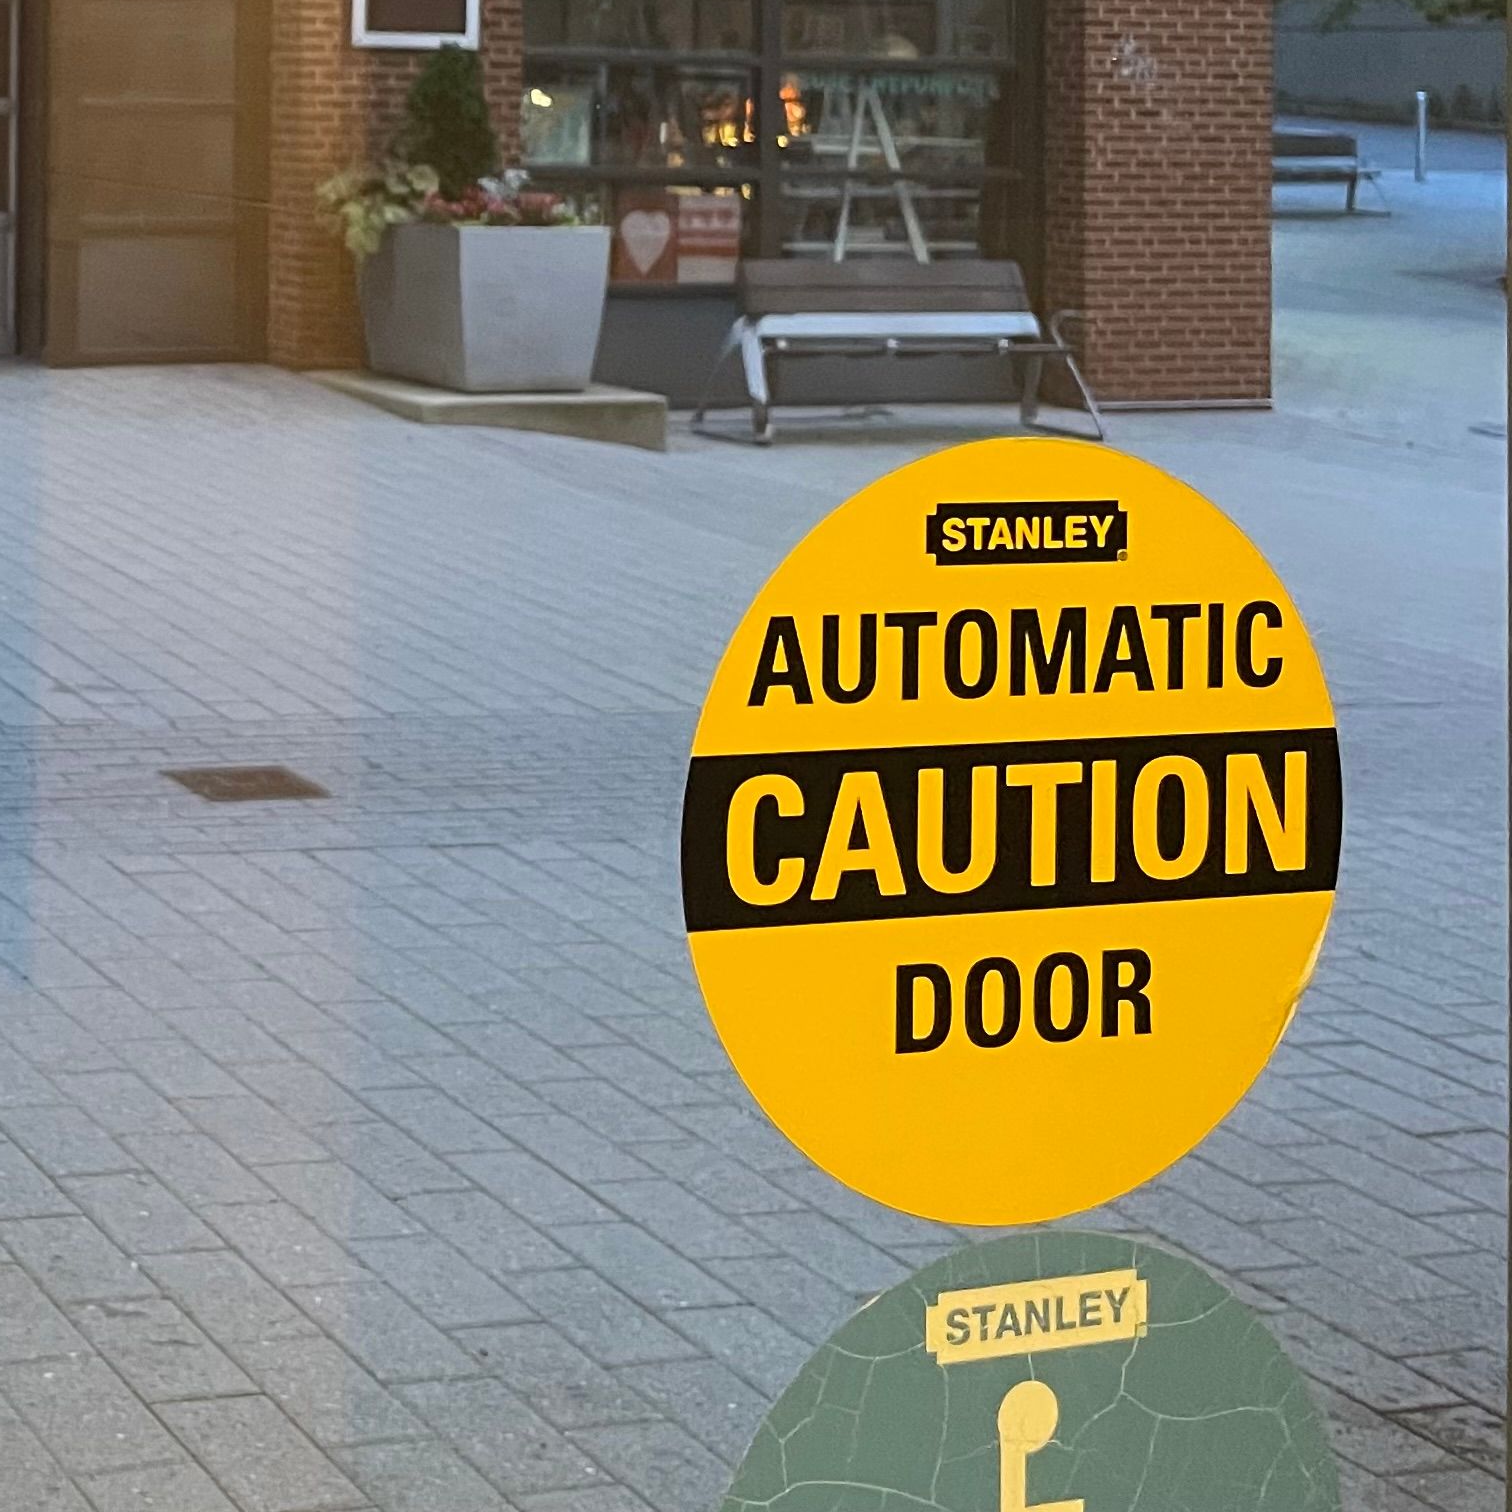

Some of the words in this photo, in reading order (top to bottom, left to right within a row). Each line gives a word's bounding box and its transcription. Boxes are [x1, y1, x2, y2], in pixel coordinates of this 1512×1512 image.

[941, 514, 1115, 552] STANLEY
[748, 600, 1284, 707] AUTOMATIC
[725, 750, 1308, 906] CAUTION
[894, 948, 1153, 1054] DOOR
[944, 1287, 1132, 1346] STANLEY
